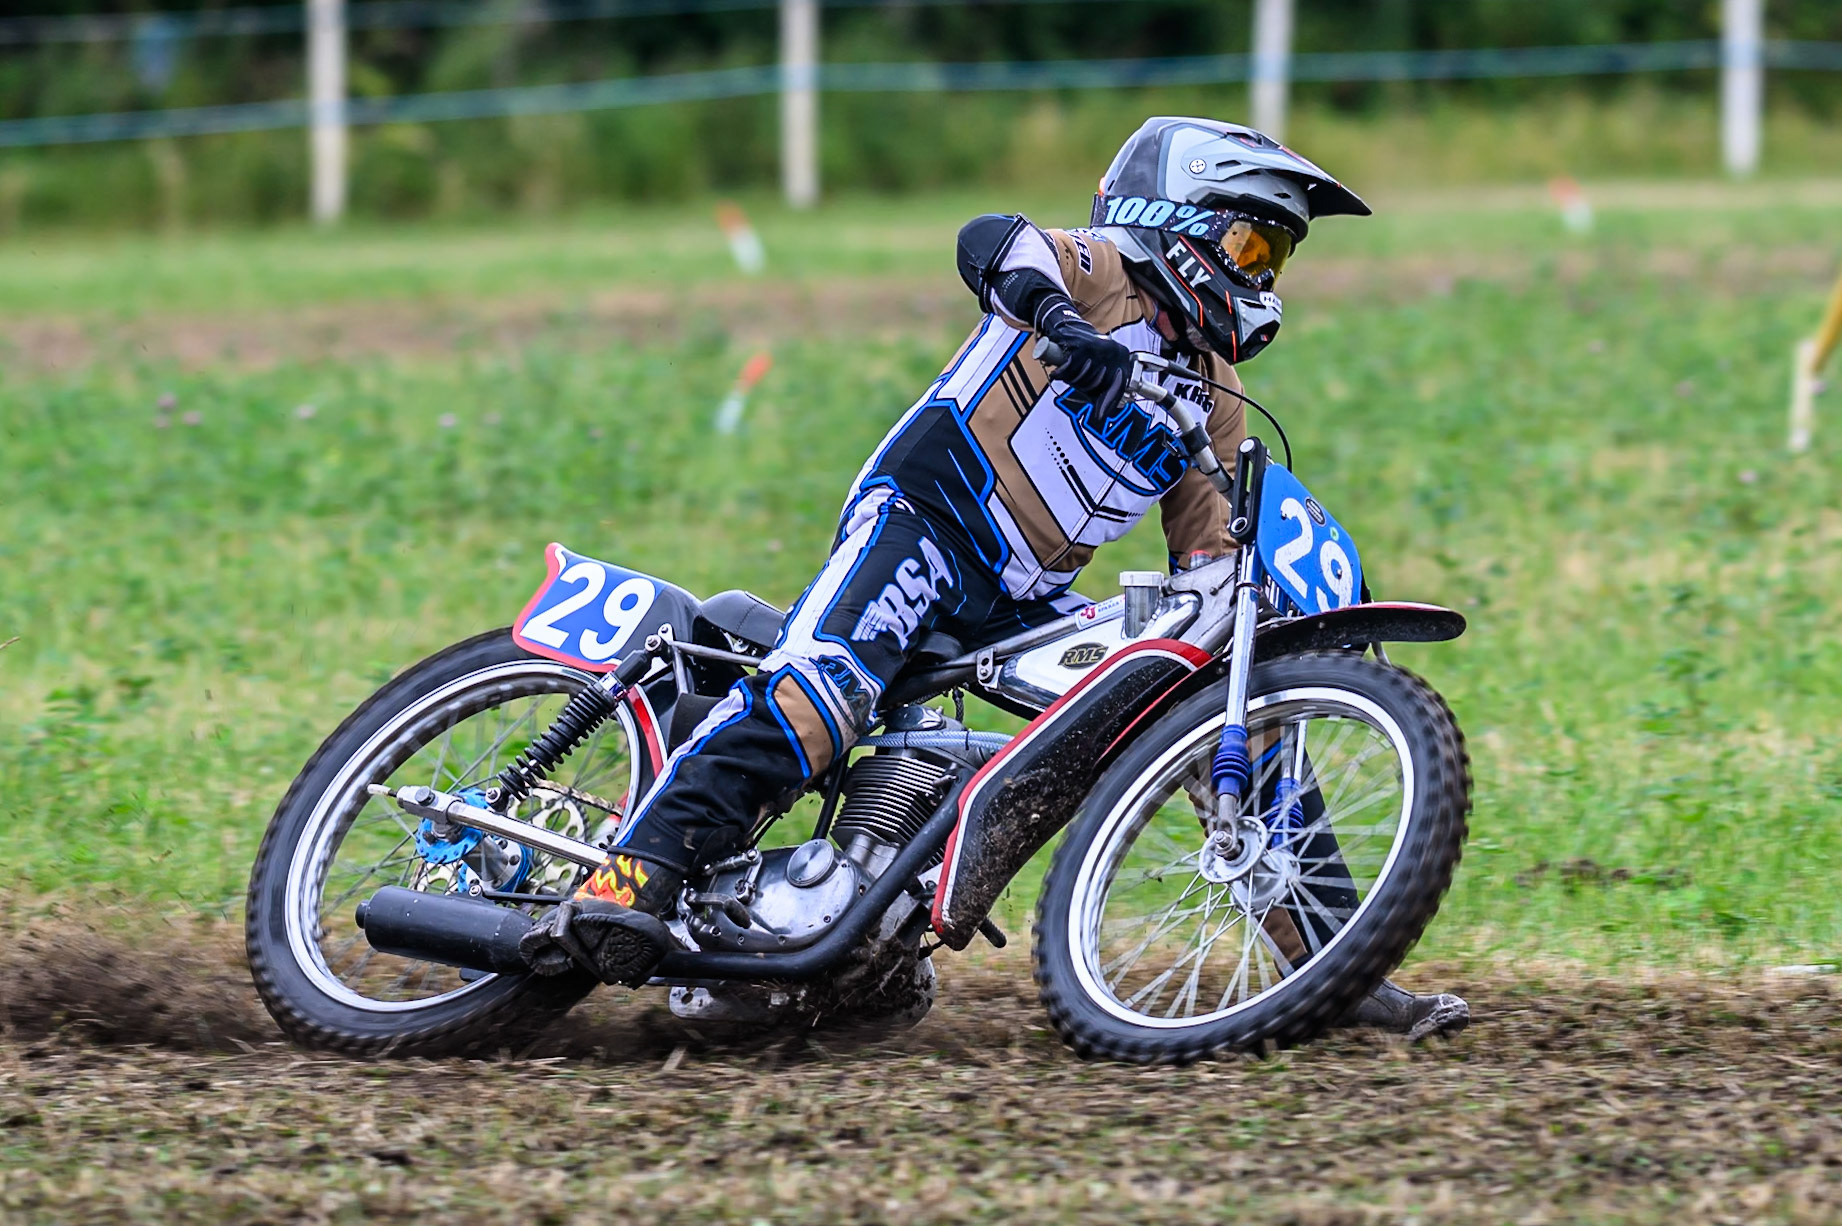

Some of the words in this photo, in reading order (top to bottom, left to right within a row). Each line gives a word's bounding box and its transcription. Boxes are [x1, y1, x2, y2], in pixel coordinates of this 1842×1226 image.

[1104, 196, 1215, 237] 100%
[1165, 240, 1212, 289] FLY
[1273, 498, 1354, 613] 29
[519, 561, 656, 661] 29
[866, 536, 954, 650] BSA
[1058, 645, 1109, 666] RMS
